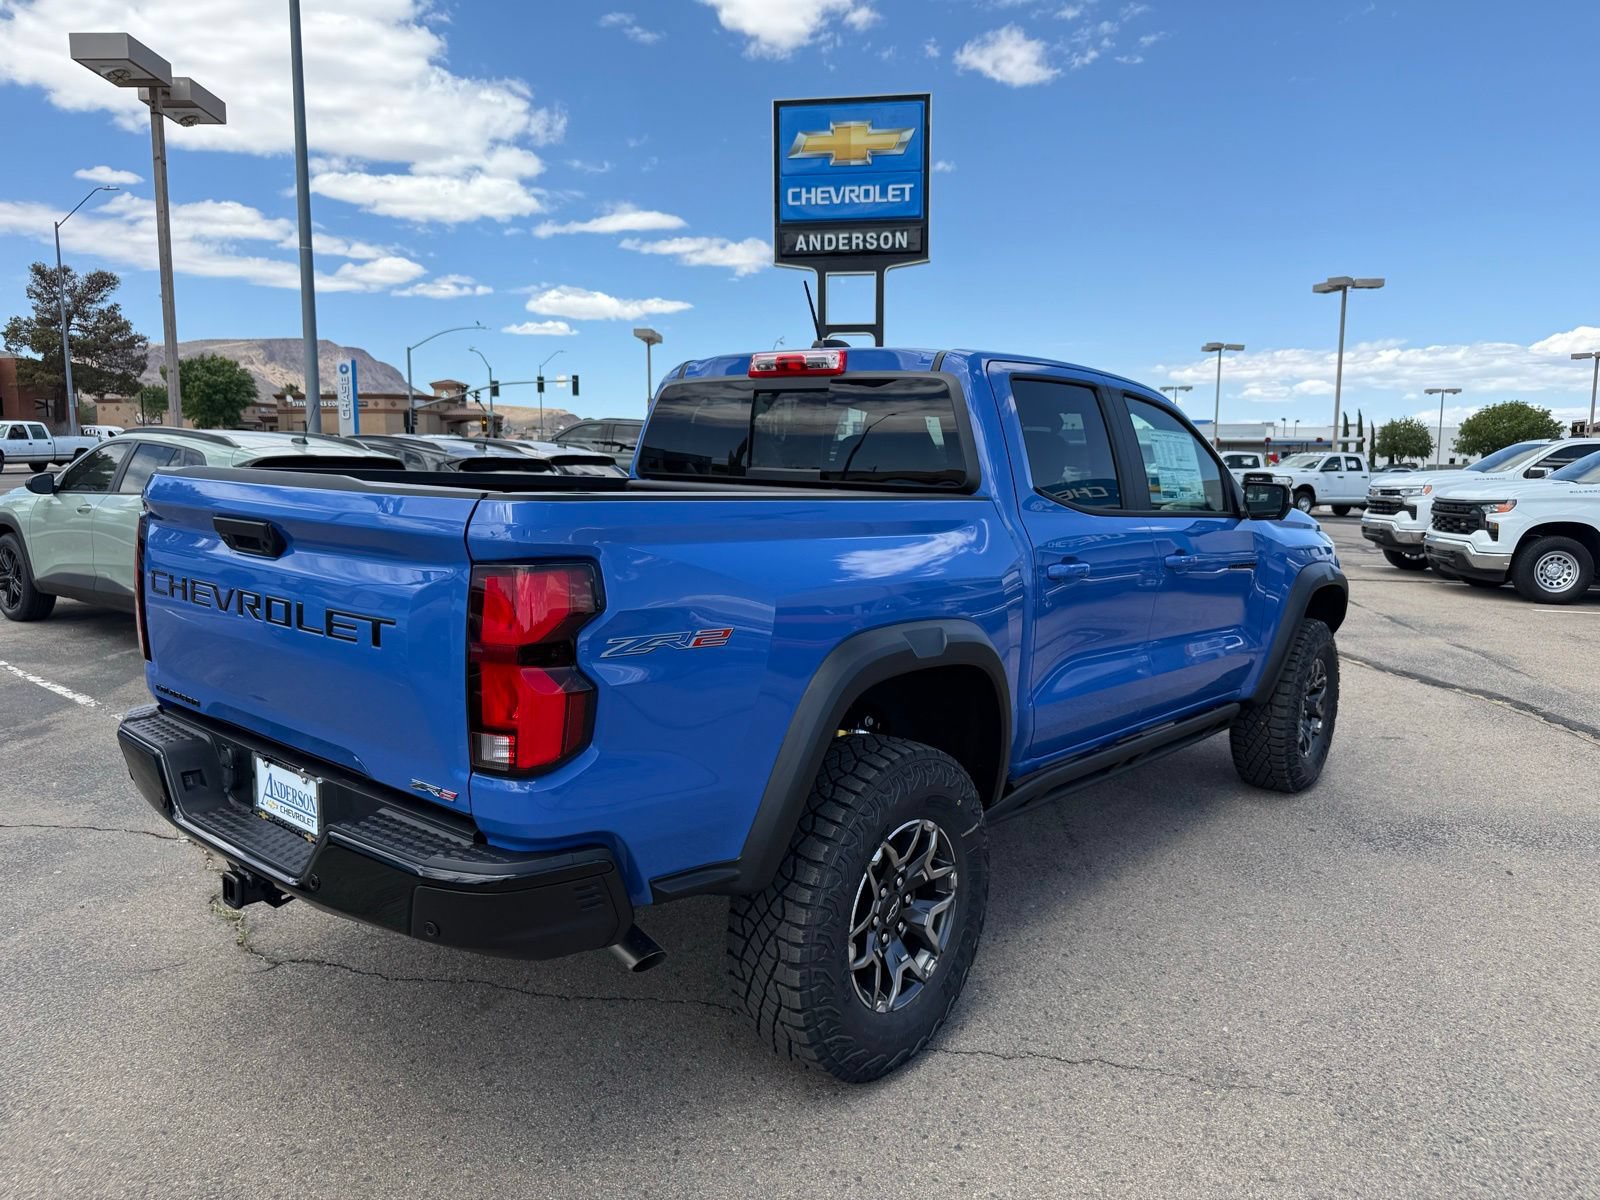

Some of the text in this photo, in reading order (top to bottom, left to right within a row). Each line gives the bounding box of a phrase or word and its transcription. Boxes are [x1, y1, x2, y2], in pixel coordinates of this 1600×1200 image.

[787, 184, 914, 205] CHEVROLET
[795, 231, 908, 252] ANDERSON
[340, 375, 351, 421] CHASE
[150, 569, 396, 649] CHEVROLET
[599, 627, 734, 658] ZR2
[261, 772, 317, 814] ANDERSON
[279, 805, 315, 828] CHEVROLET
